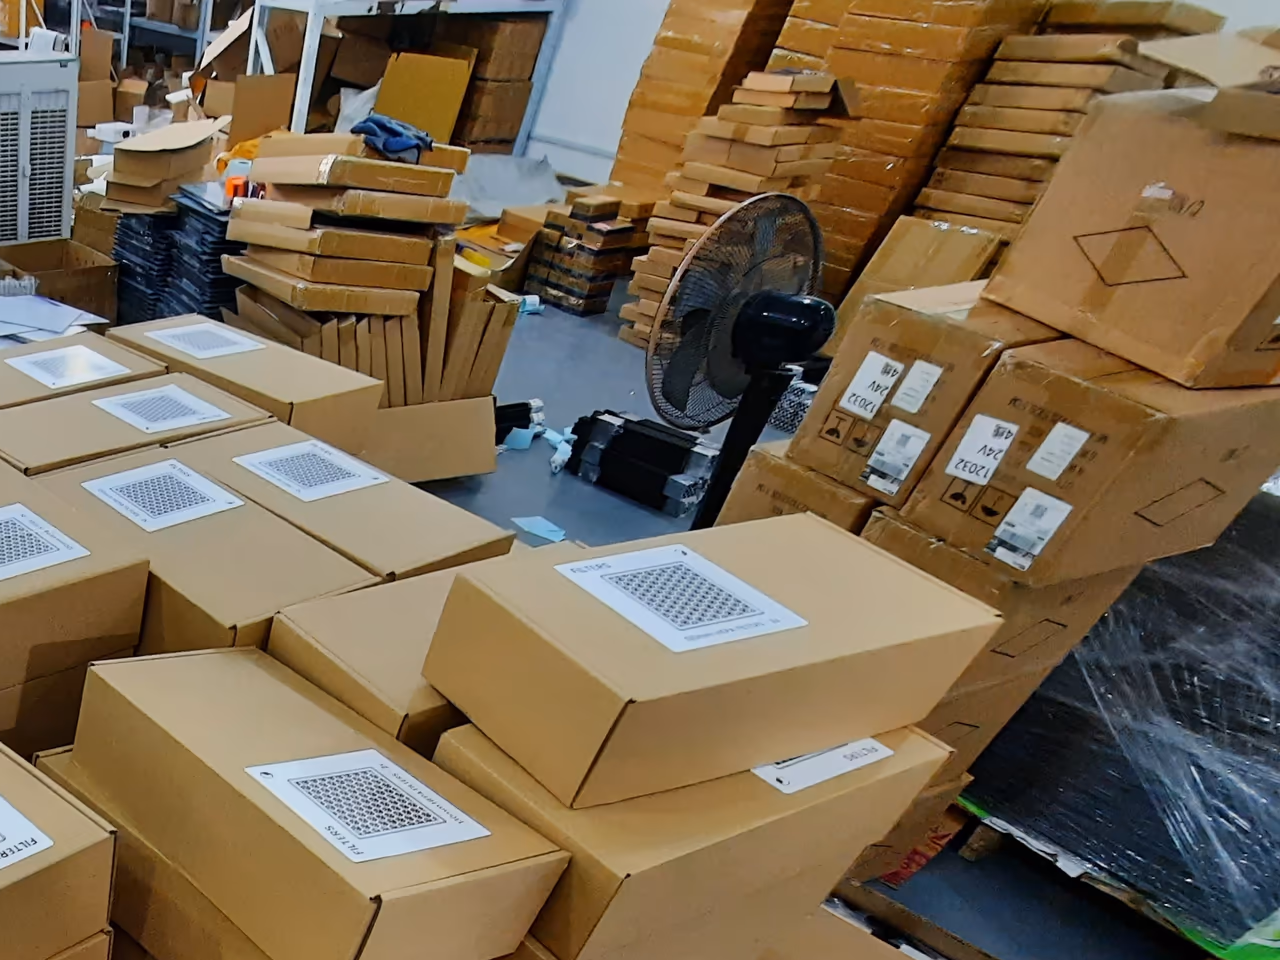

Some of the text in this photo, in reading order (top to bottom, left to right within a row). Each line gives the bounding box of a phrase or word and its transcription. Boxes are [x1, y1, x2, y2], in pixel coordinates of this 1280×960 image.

[867, 380, 890, 396] 24V
[847, 392, 877, 414] 12032
[977, 444, 1004, 461] 24V
[954, 457, 991, 479] 12032
[324, 824, 365, 856] FILTERS
